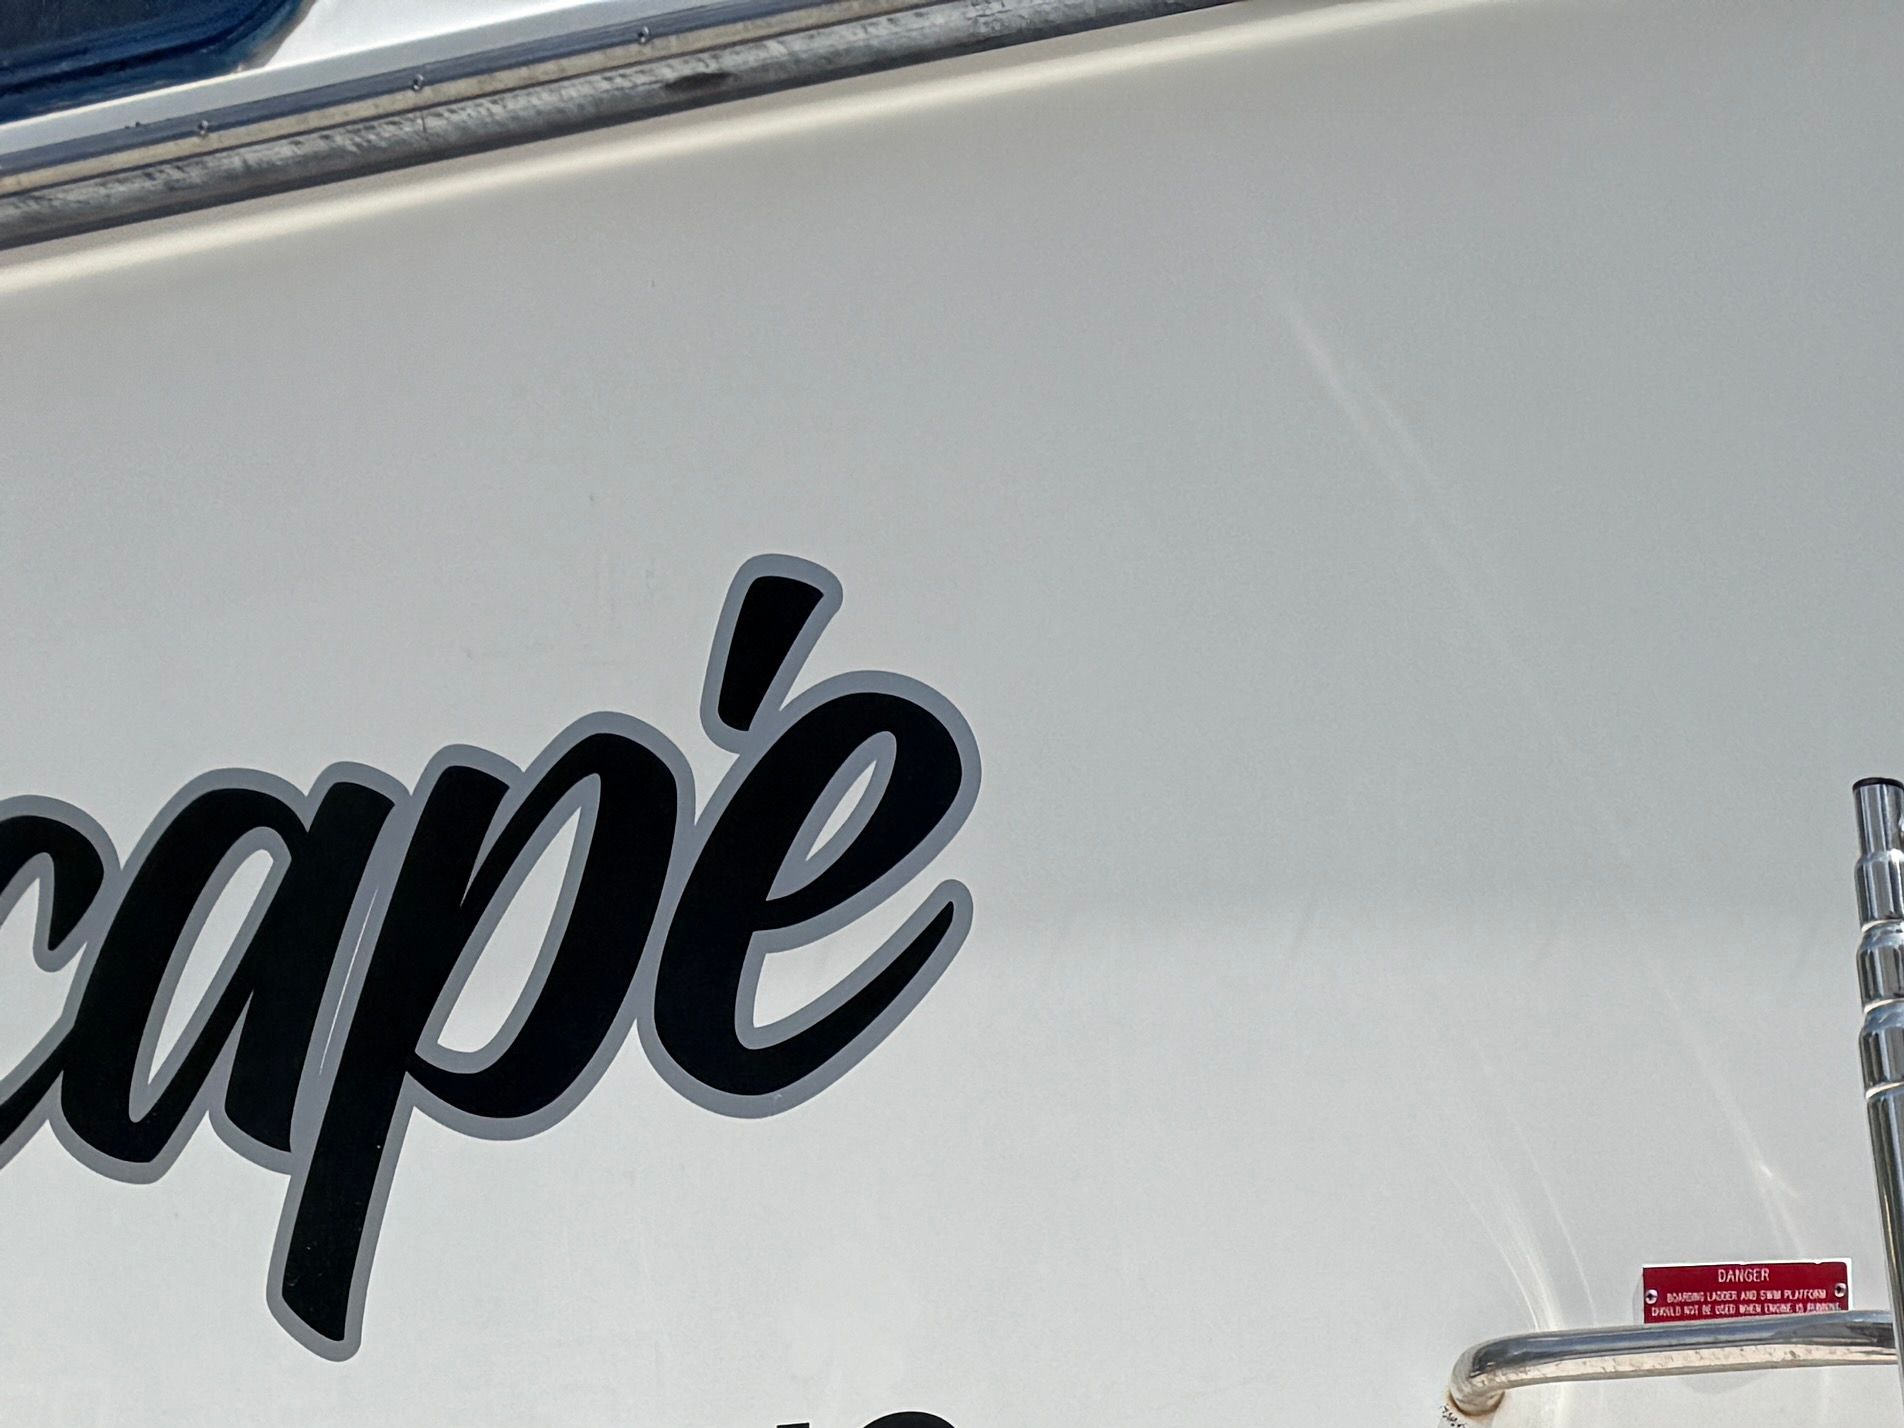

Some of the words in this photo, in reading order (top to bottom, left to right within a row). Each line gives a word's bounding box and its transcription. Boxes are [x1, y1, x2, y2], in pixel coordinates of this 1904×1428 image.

[1717, 1268, 1770, 1283] DANGER
[1666, 1291, 1705, 1303] BOARDING
[1706, 1290, 1738, 1302] LADDER
[1740, 1289, 1757, 1300] AND
[1760, 1289, 1781, 1300] SWIM
[1783, 1288, 1827, 1300] PLATFORM
[1683, 1304, 1699, 1316] NOT
